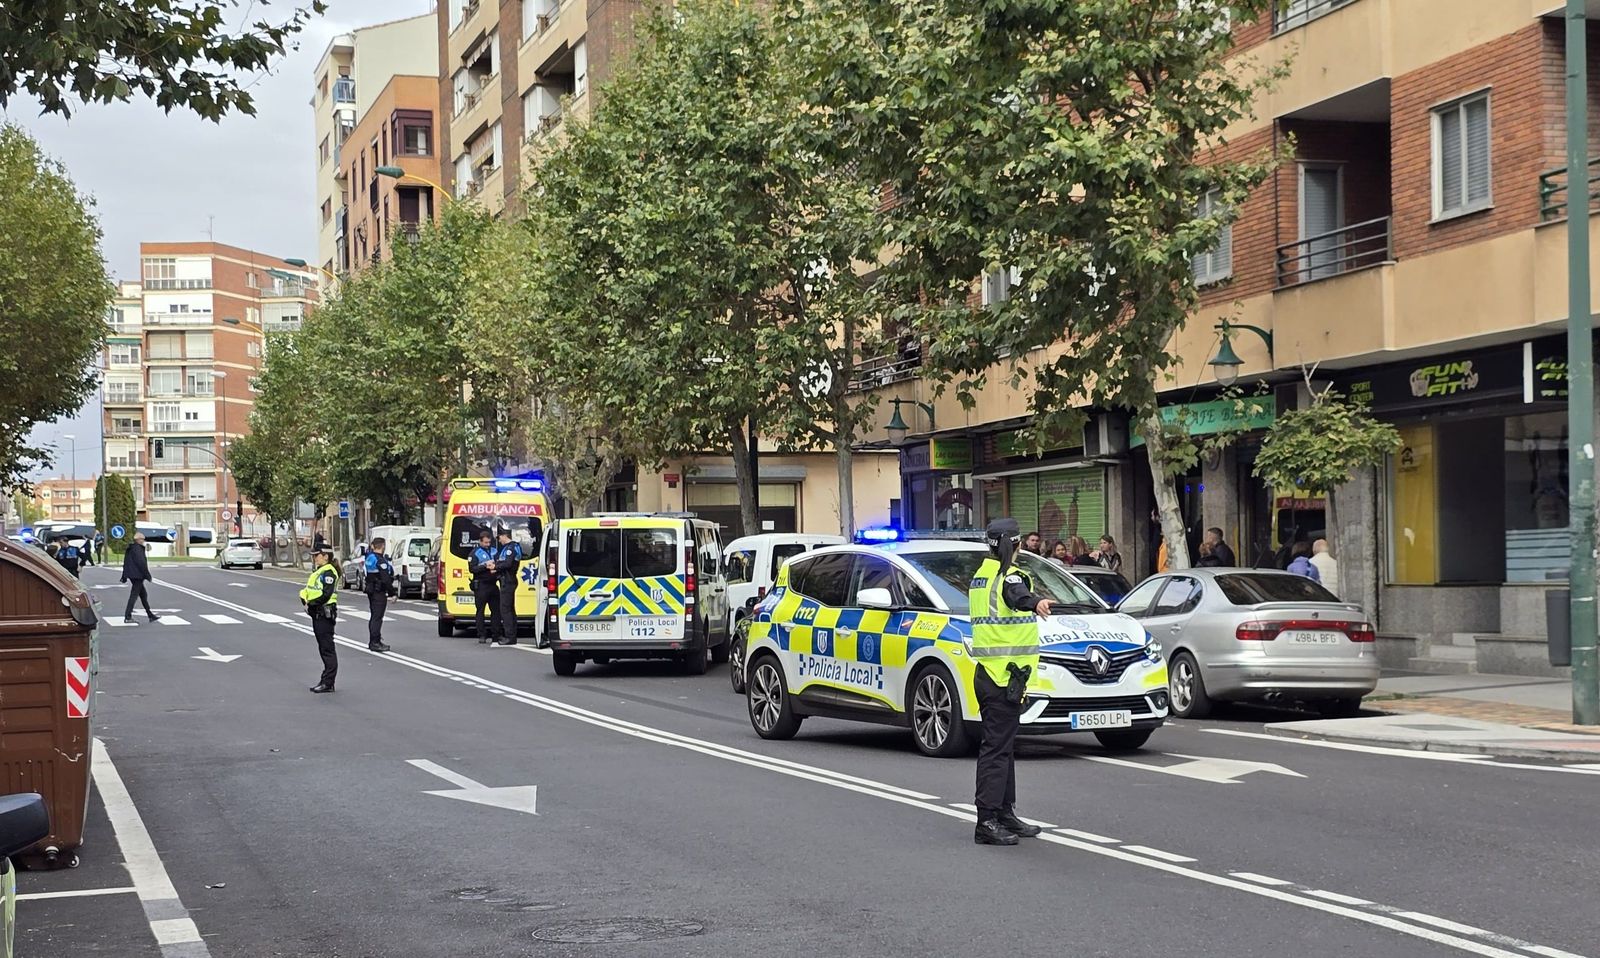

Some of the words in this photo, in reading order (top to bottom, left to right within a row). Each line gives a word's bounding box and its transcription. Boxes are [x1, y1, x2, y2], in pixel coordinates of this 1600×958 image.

[1421, 361, 1467, 377] FUN
[1426, 381, 1462, 397] FIT
[458, 504, 537, 514] AMBULANCIA
[798, 607, 816, 620] 112
[574, 623, 594, 632] 5569
[596, 623, 611, 632] LRC
[658, 618, 677, 626] Local
[636, 628, 655, 636] 112
[1296, 633, 1317, 643] 4984
[808, 657, 841, 680] Policía
[844, 664, 873, 686] Local
[1079, 713, 1106, 726] 5650
[1109, 712, 1128, 725] LPL
